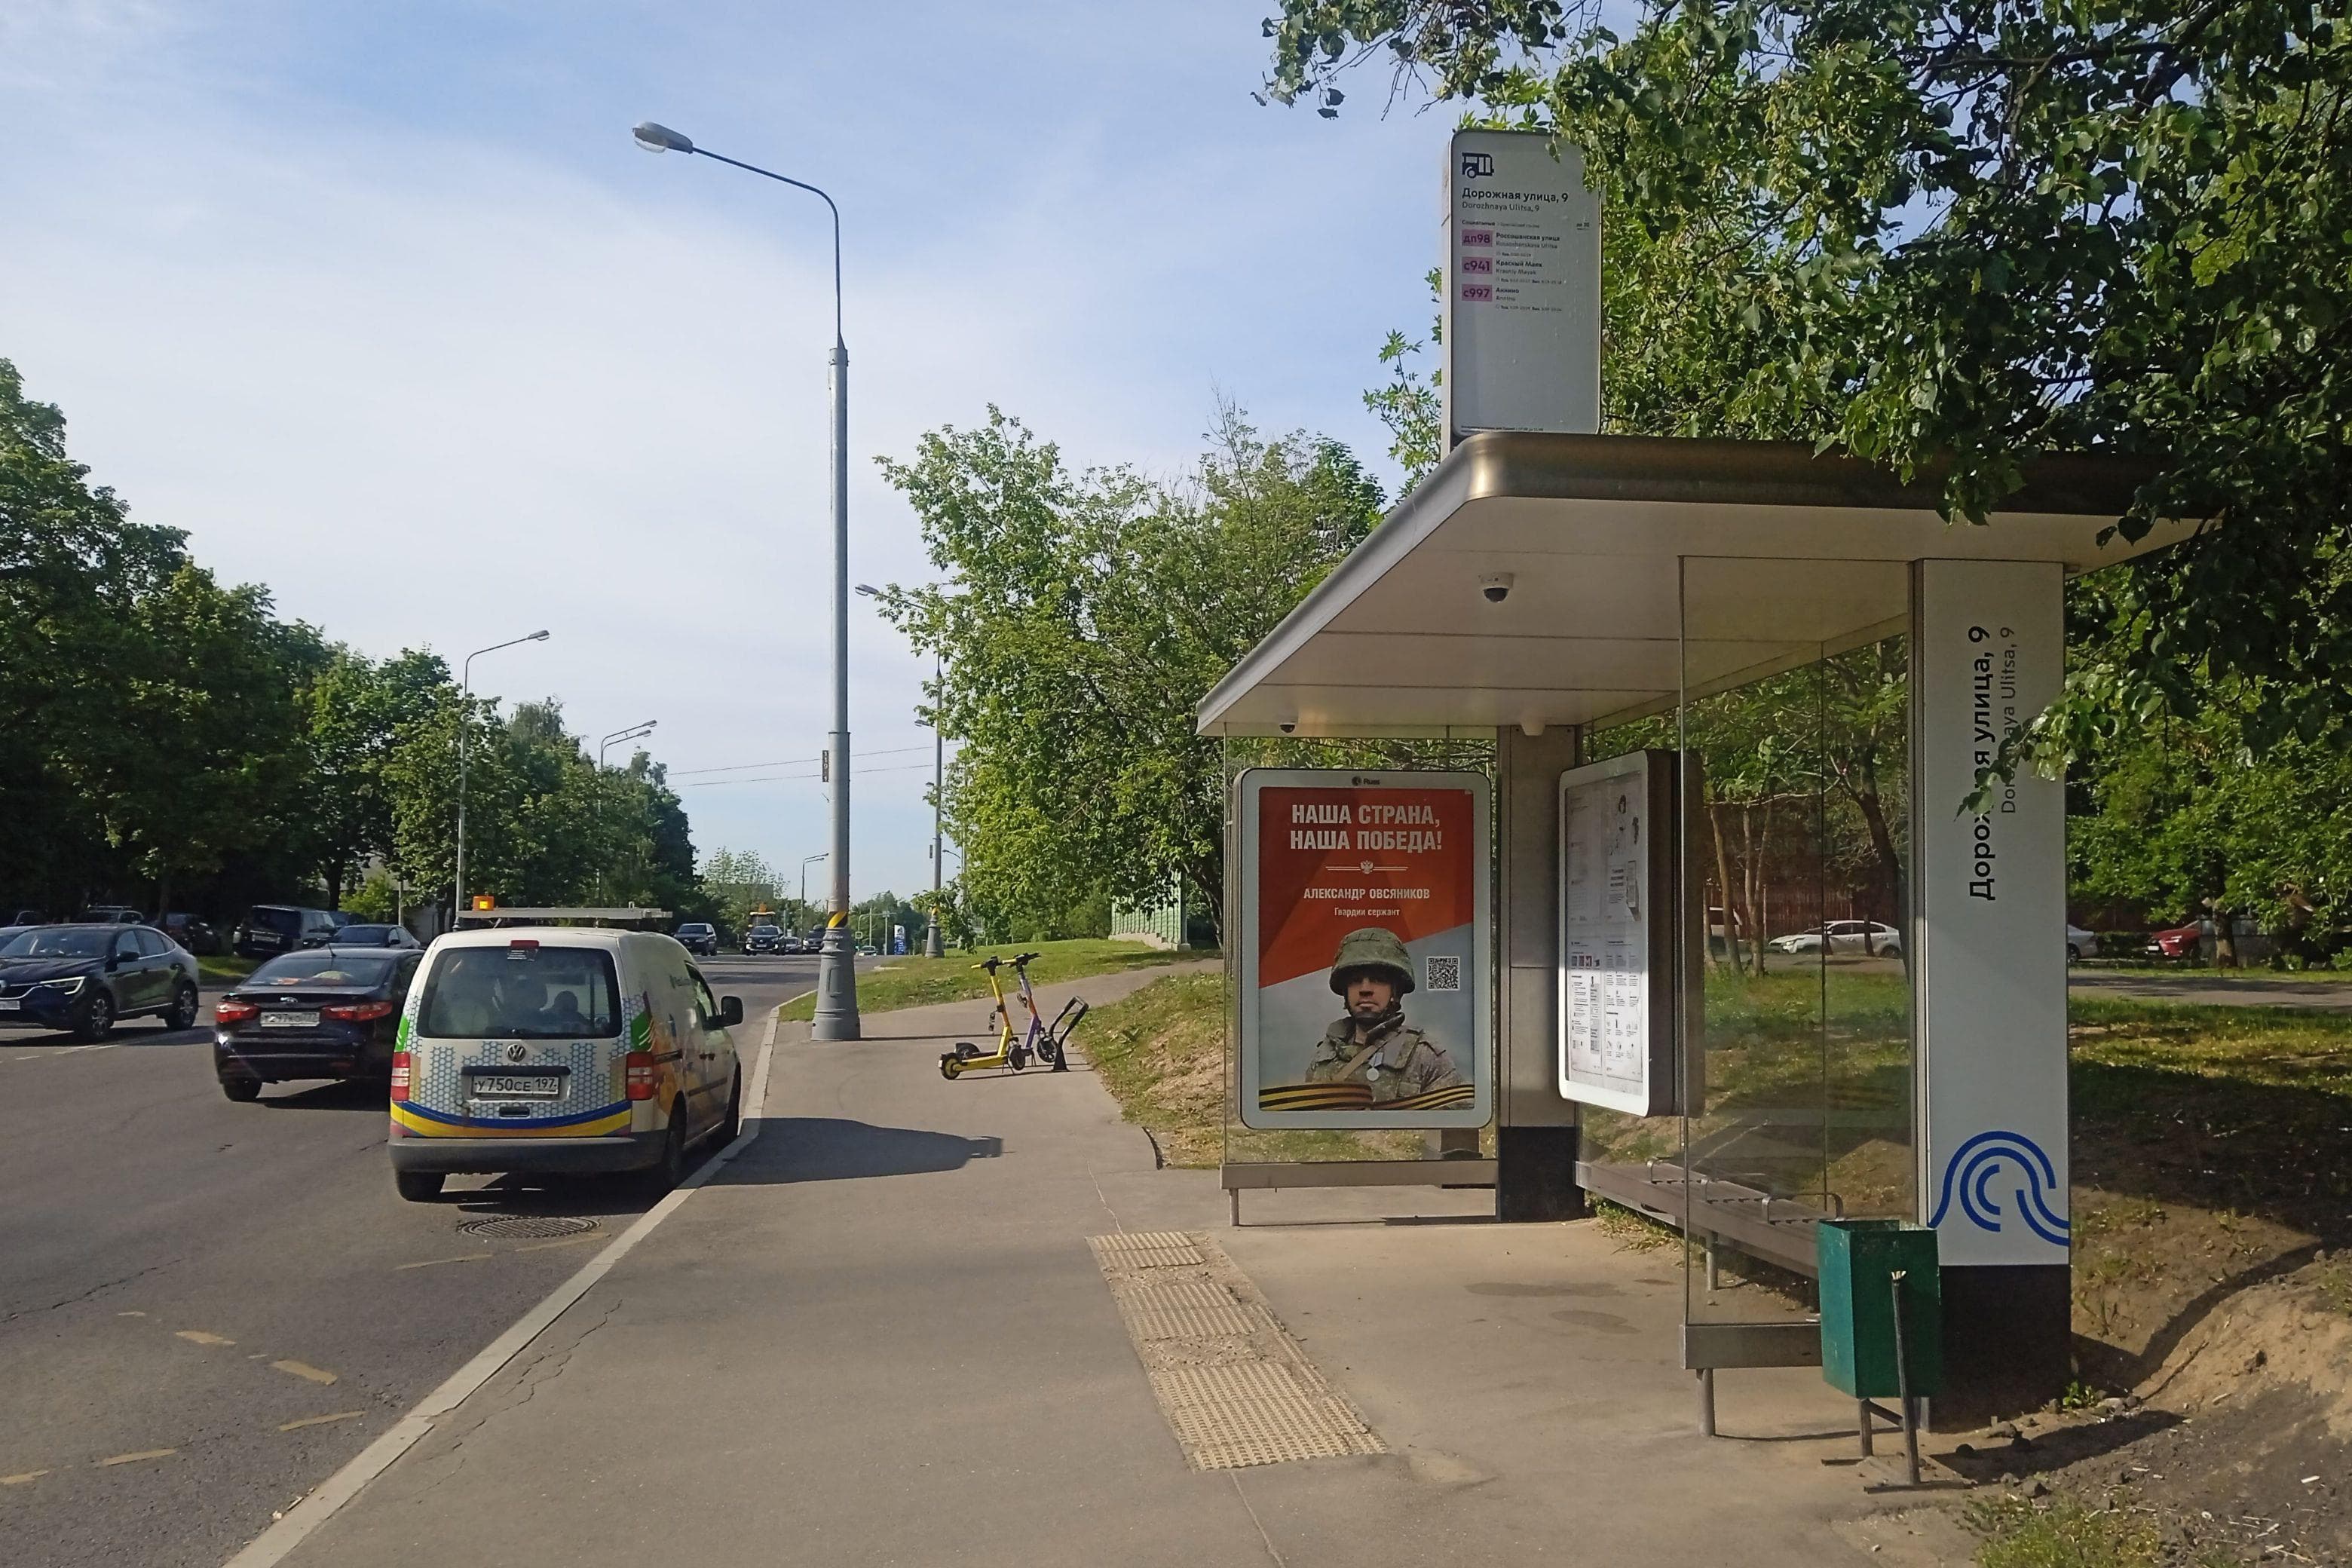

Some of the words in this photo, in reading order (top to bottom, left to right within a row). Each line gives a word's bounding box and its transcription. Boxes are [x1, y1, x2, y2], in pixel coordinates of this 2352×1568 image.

[1462, 188, 1521, 200] Дорожная
[1523, 193, 1560, 204] улица,
[1561, 192, 1569, 202] 9
[1462, 201, 1508, 211] Dorozhnaya
[1509, 204, 1534, 212] Ulitsa,
[1463, 234, 1491, 243] дп98
[1463, 260, 1490, 271] с941
[1463, 288, 1490, 298] с997
[1968, 626, 1991, 644] 9
[2000, 626, 2015, 639] 9
[2000, 644, 2018, 700] Ulitsa,
[1973, 651, 1996, 743] улица,
[1291, 804, 1352, 824] НАША
[1358, 804, 1441, 828] СТРАНА,
[1969, 749, 1996, 901] Дороя
[1290, 830, 1351, 850] НАША
[1356, 830, 1443, 854] ПОБЕДА!
[1303, 888, 1366, 901] АЛЕКСАНДР
[1369, 888, 1431, 899] ОВСЯНИКОВ
[1334, 907, 1366, 917] Гвардии
[1367, 908, 1401, 917] сержант
[477, 1077, 531, 1092] У750СЕ
[535, 1078, 556, 1089] 197
